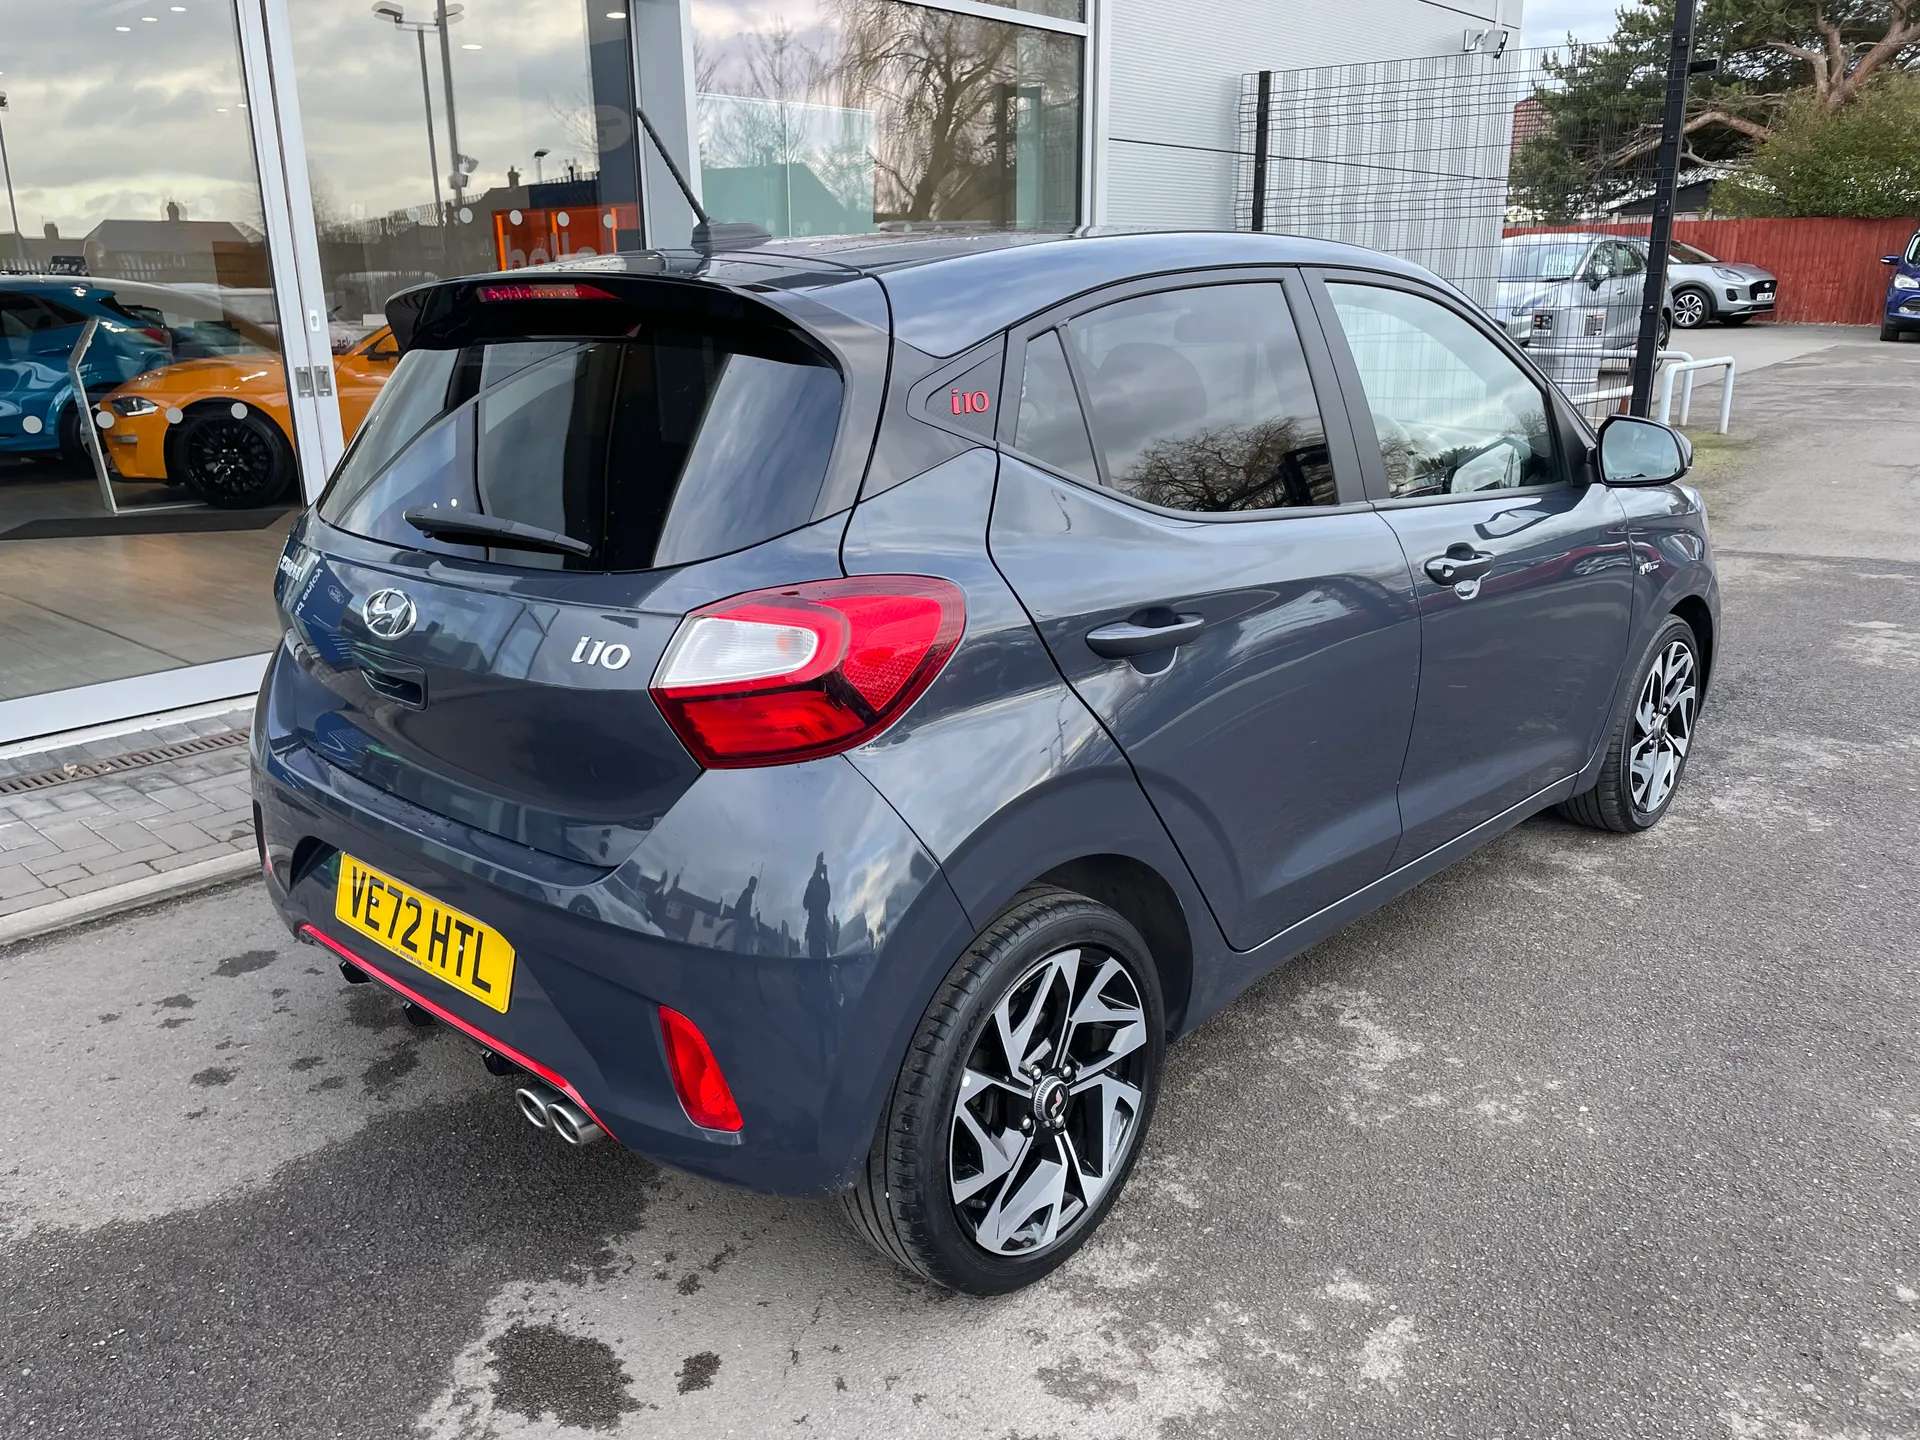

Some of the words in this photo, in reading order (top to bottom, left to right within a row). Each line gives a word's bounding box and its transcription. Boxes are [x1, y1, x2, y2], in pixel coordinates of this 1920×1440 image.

[951, 388, 990, 415] i10
[571, 636, 631, 670] i10
[351, 866, 422, 953] VE72
[428, 909, 492, 993] HTL
